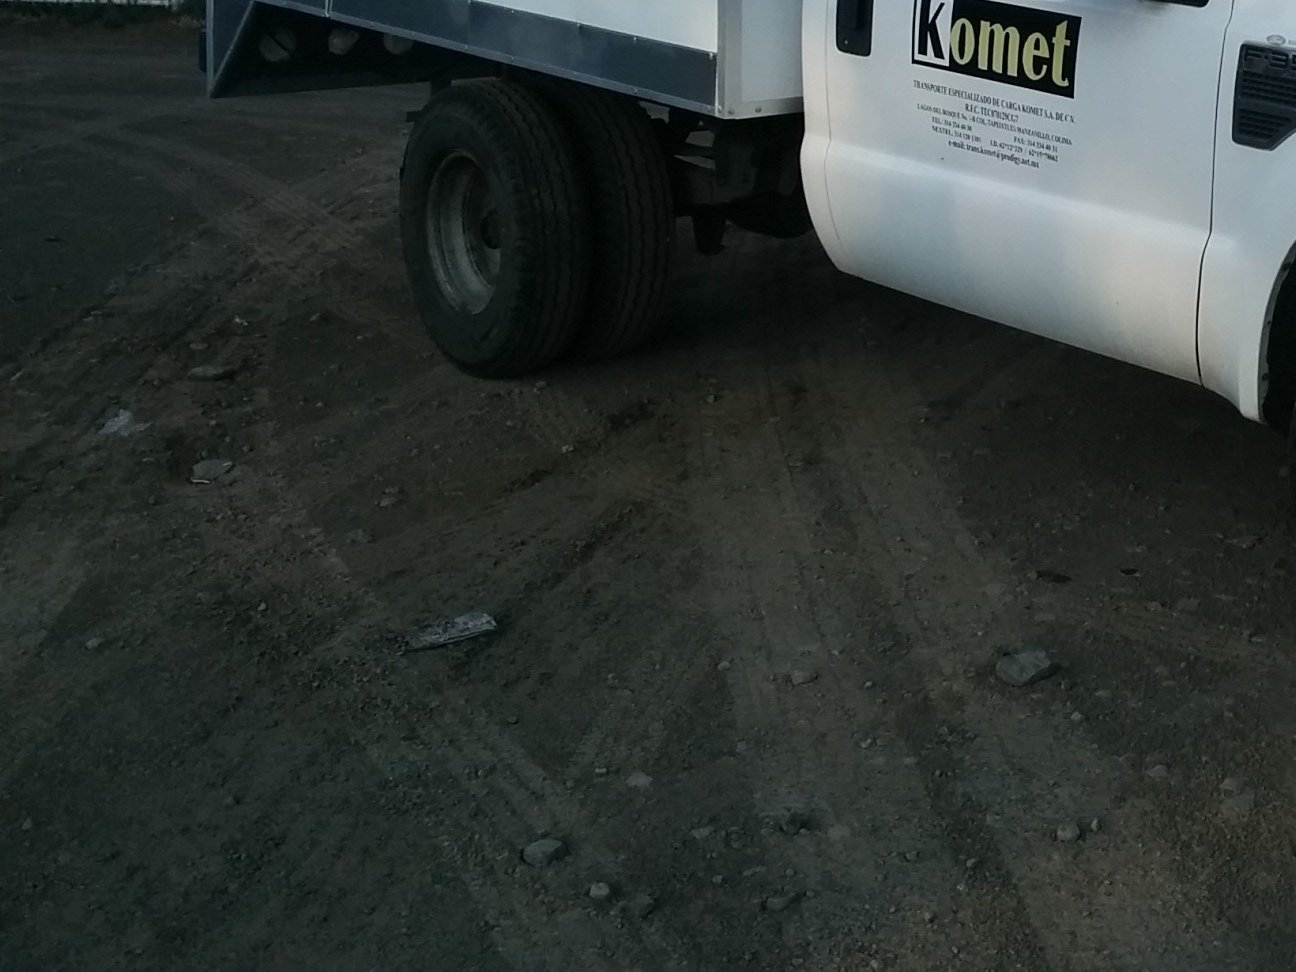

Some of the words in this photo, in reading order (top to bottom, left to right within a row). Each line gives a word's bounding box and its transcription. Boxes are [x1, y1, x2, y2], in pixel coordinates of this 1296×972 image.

[913, 79, 947, 95] TRANSPORTE
[948, 88, 991, 105] ESPECIALIZADO
[992, 97, 1000, 107] DE
[1000, 99, 1021, 112] CARGA
[1021, 104, 1043, 117] KOMET
[1055, 112, 1064, 122] DE
